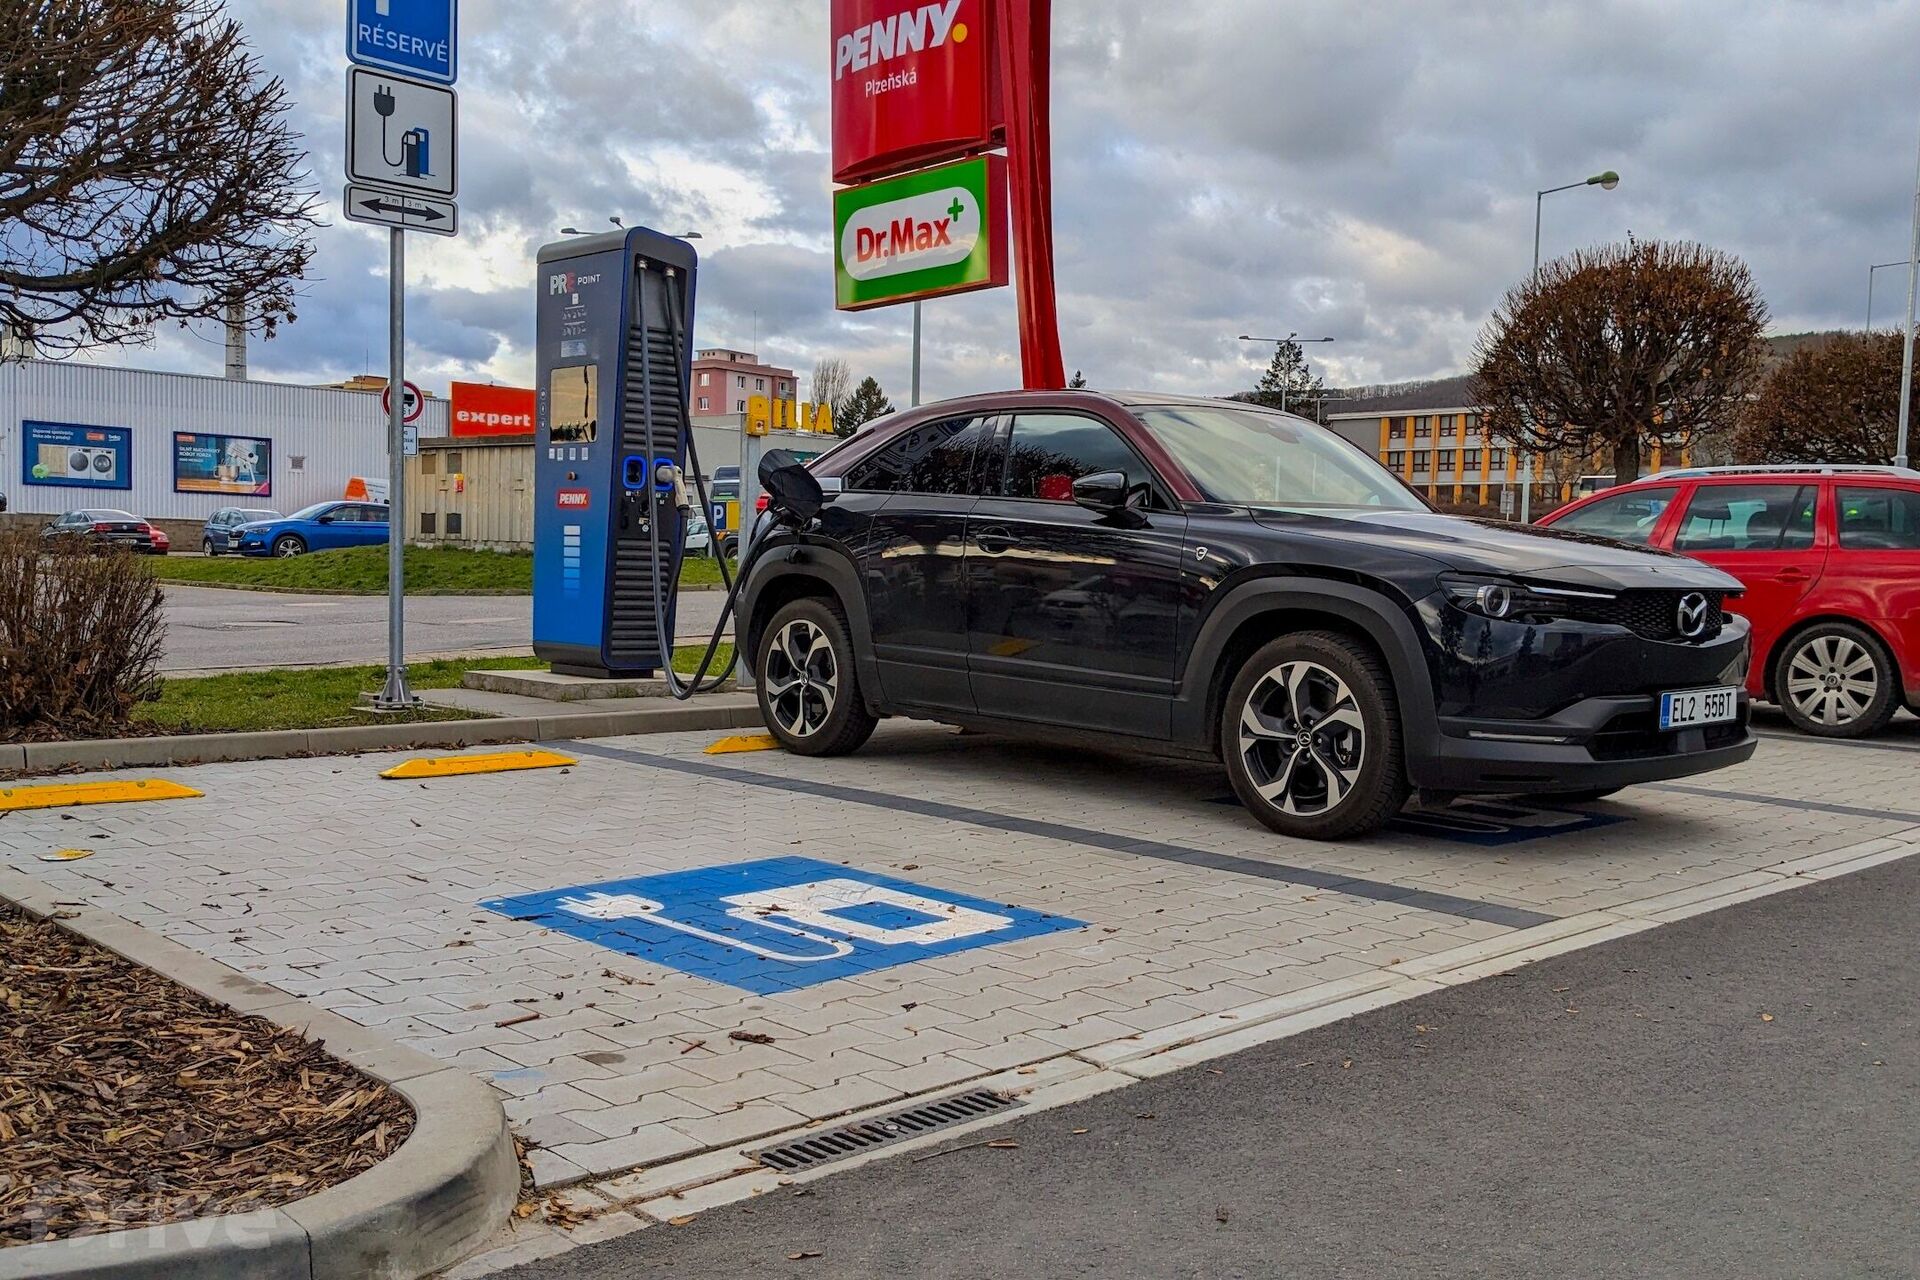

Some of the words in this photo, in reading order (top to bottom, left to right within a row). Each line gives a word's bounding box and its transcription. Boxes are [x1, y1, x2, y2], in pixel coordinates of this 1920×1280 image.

[358, 23, 449, 63] RÉSERVÉ
[865, 67, 917, 98] Plzeňská
[577, 274, 601, 286] POINT
[456, 410, 531, 427] expert
[713, 504, 725, 527] P
[1672, 696, 1696, 723] EL2
[1704, 692, 1732, 719] 55BT
